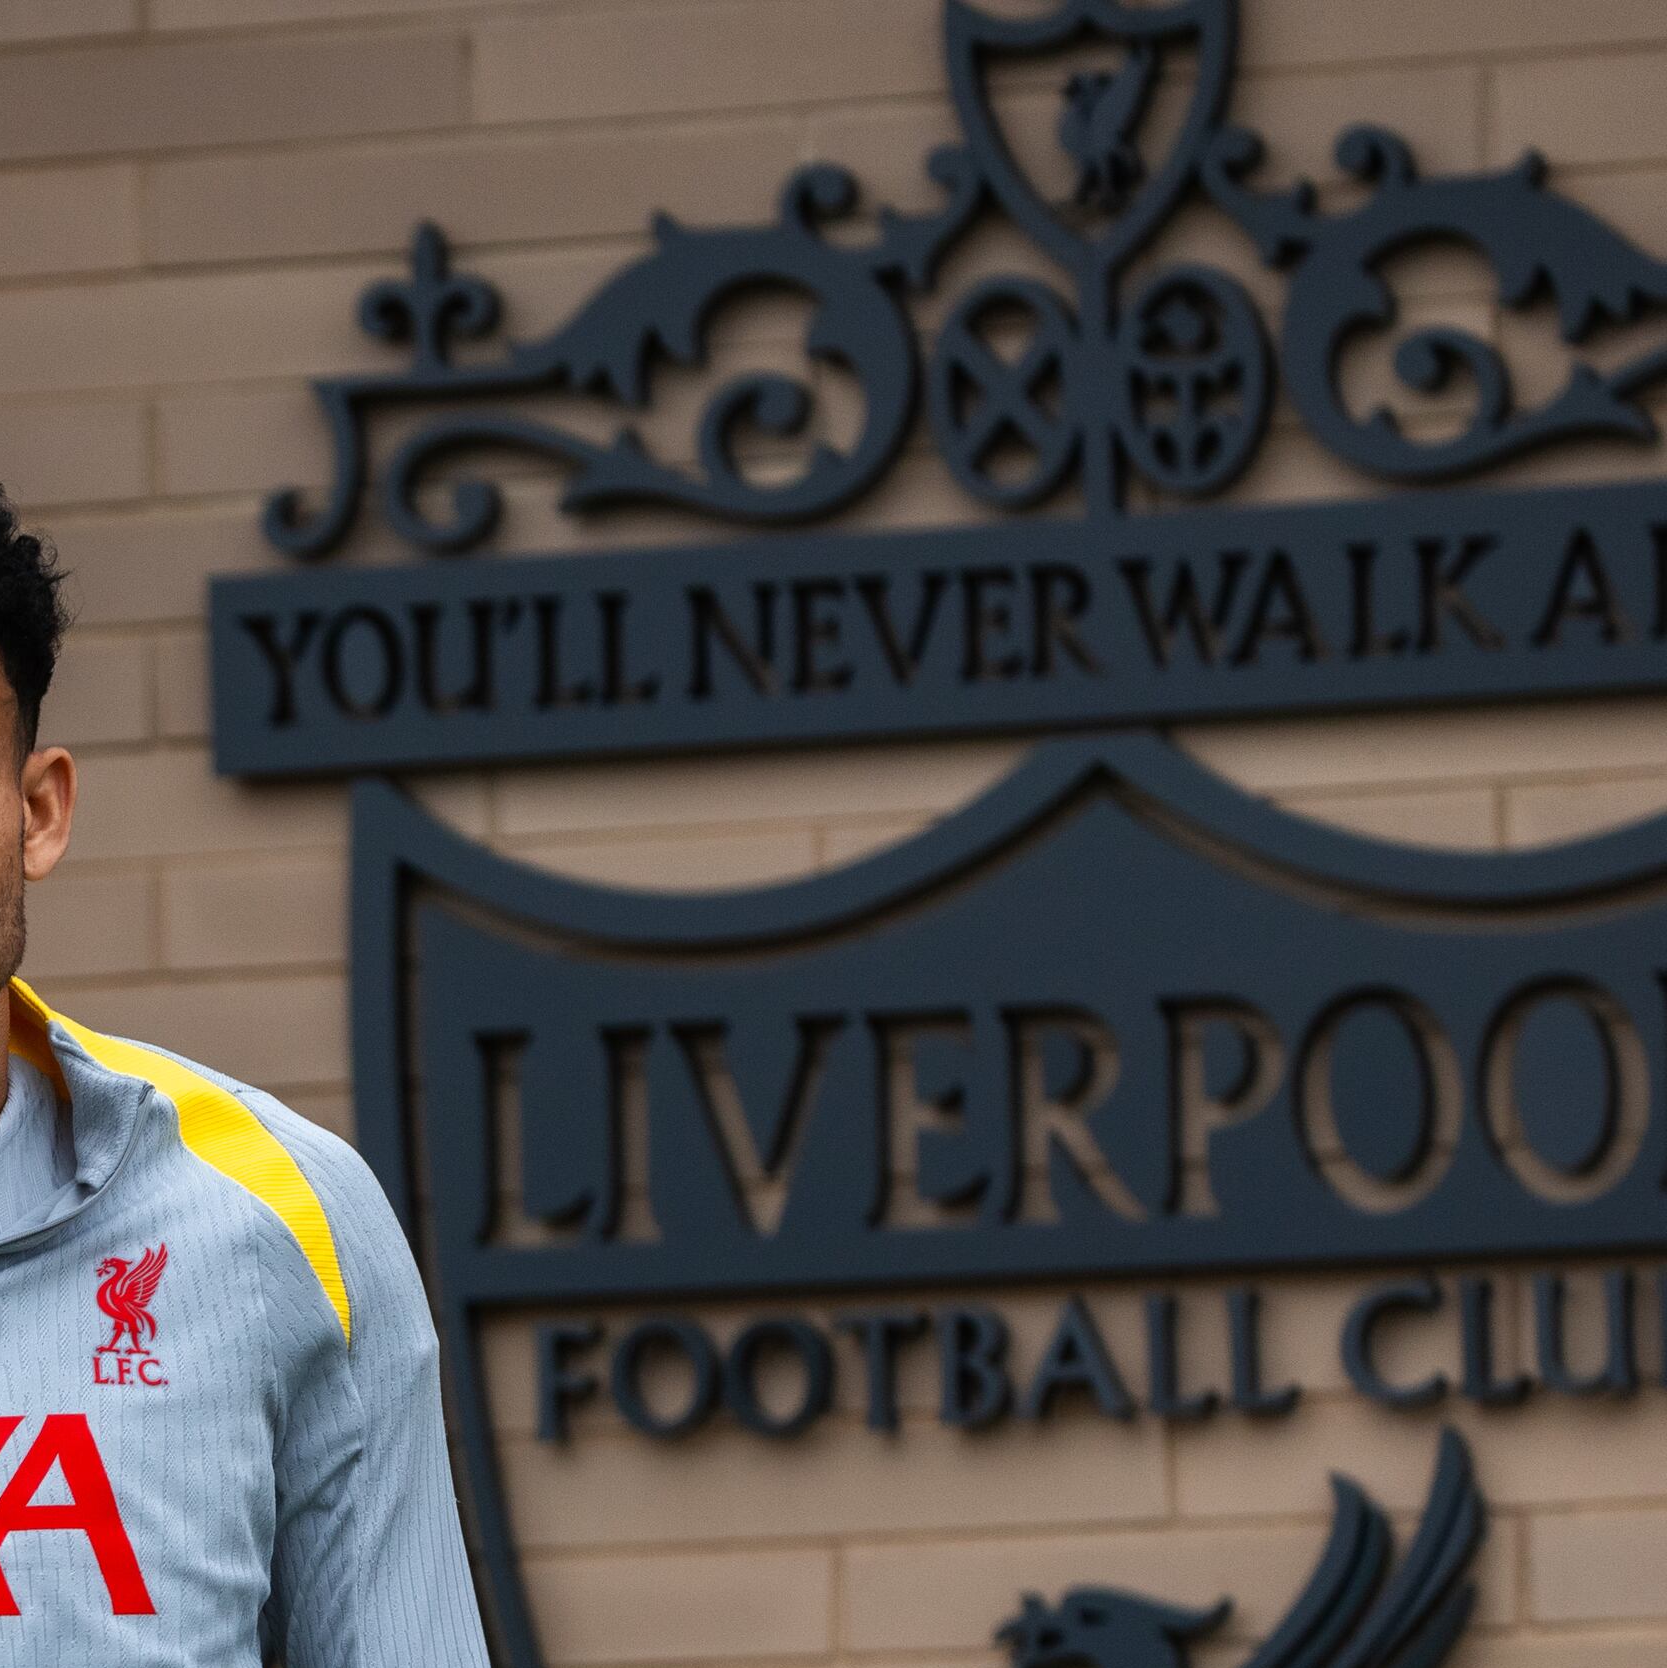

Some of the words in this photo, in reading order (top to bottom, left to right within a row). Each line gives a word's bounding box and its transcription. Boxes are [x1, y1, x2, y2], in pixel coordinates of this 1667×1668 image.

[239, 590, 659, 728] YOU'LL
[685, 562, 1107, 703] NEVER
[1113, 533, 1505, 671] WALK
[1531, 518, 1667, 650] A
[475, 968, 1667, 1250] LIVERPOO
[533, 1285, 1299, 1446] FOOTBALL
[1339, 1265, 1667, 1412] CLU
